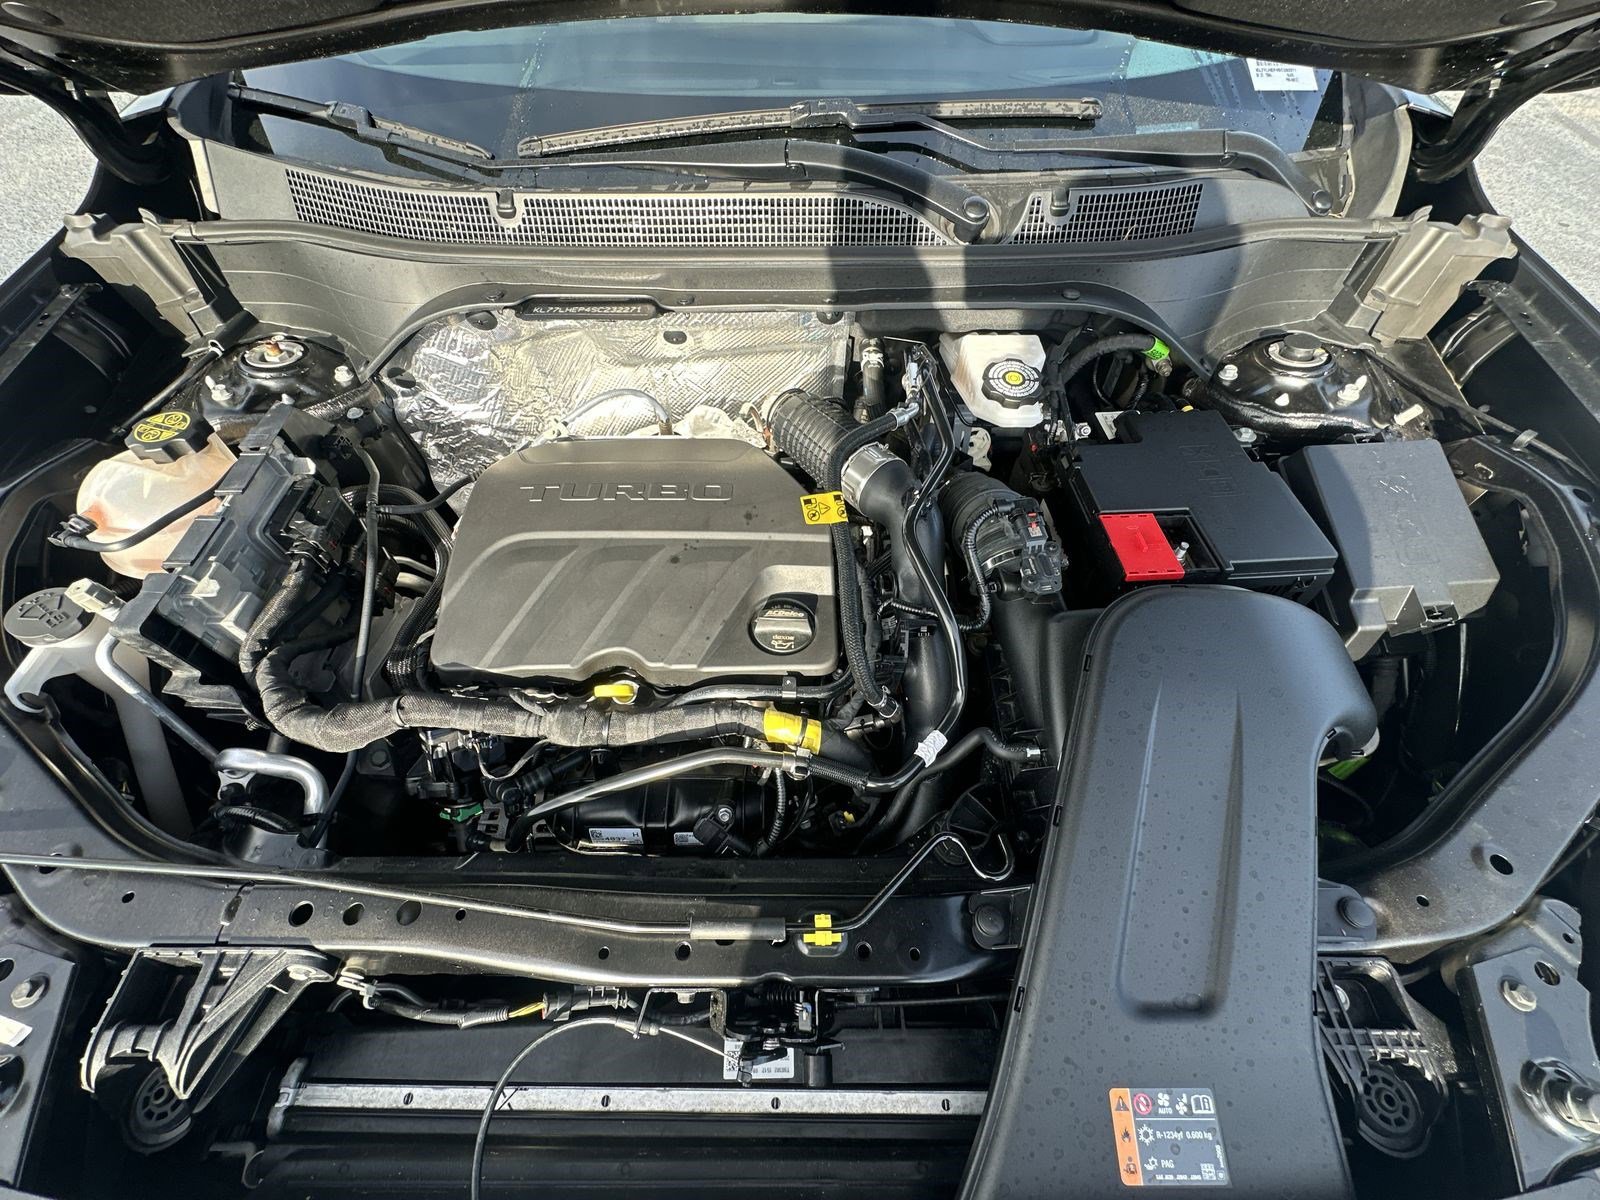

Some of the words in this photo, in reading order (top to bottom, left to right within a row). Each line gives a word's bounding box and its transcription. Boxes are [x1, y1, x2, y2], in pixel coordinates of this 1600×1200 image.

[532, 306, 642, 314] KL77LHEP4SC232271
[519, 483, 734, 502] TURBO
[1155, 1130, 1184, 1141] R-1234yf
[1185, 1131, 1203, 1139] 0.600
[1203, 1130, 1213, 1141] kg
[1160, 1159, 1175, 1169] PAG
